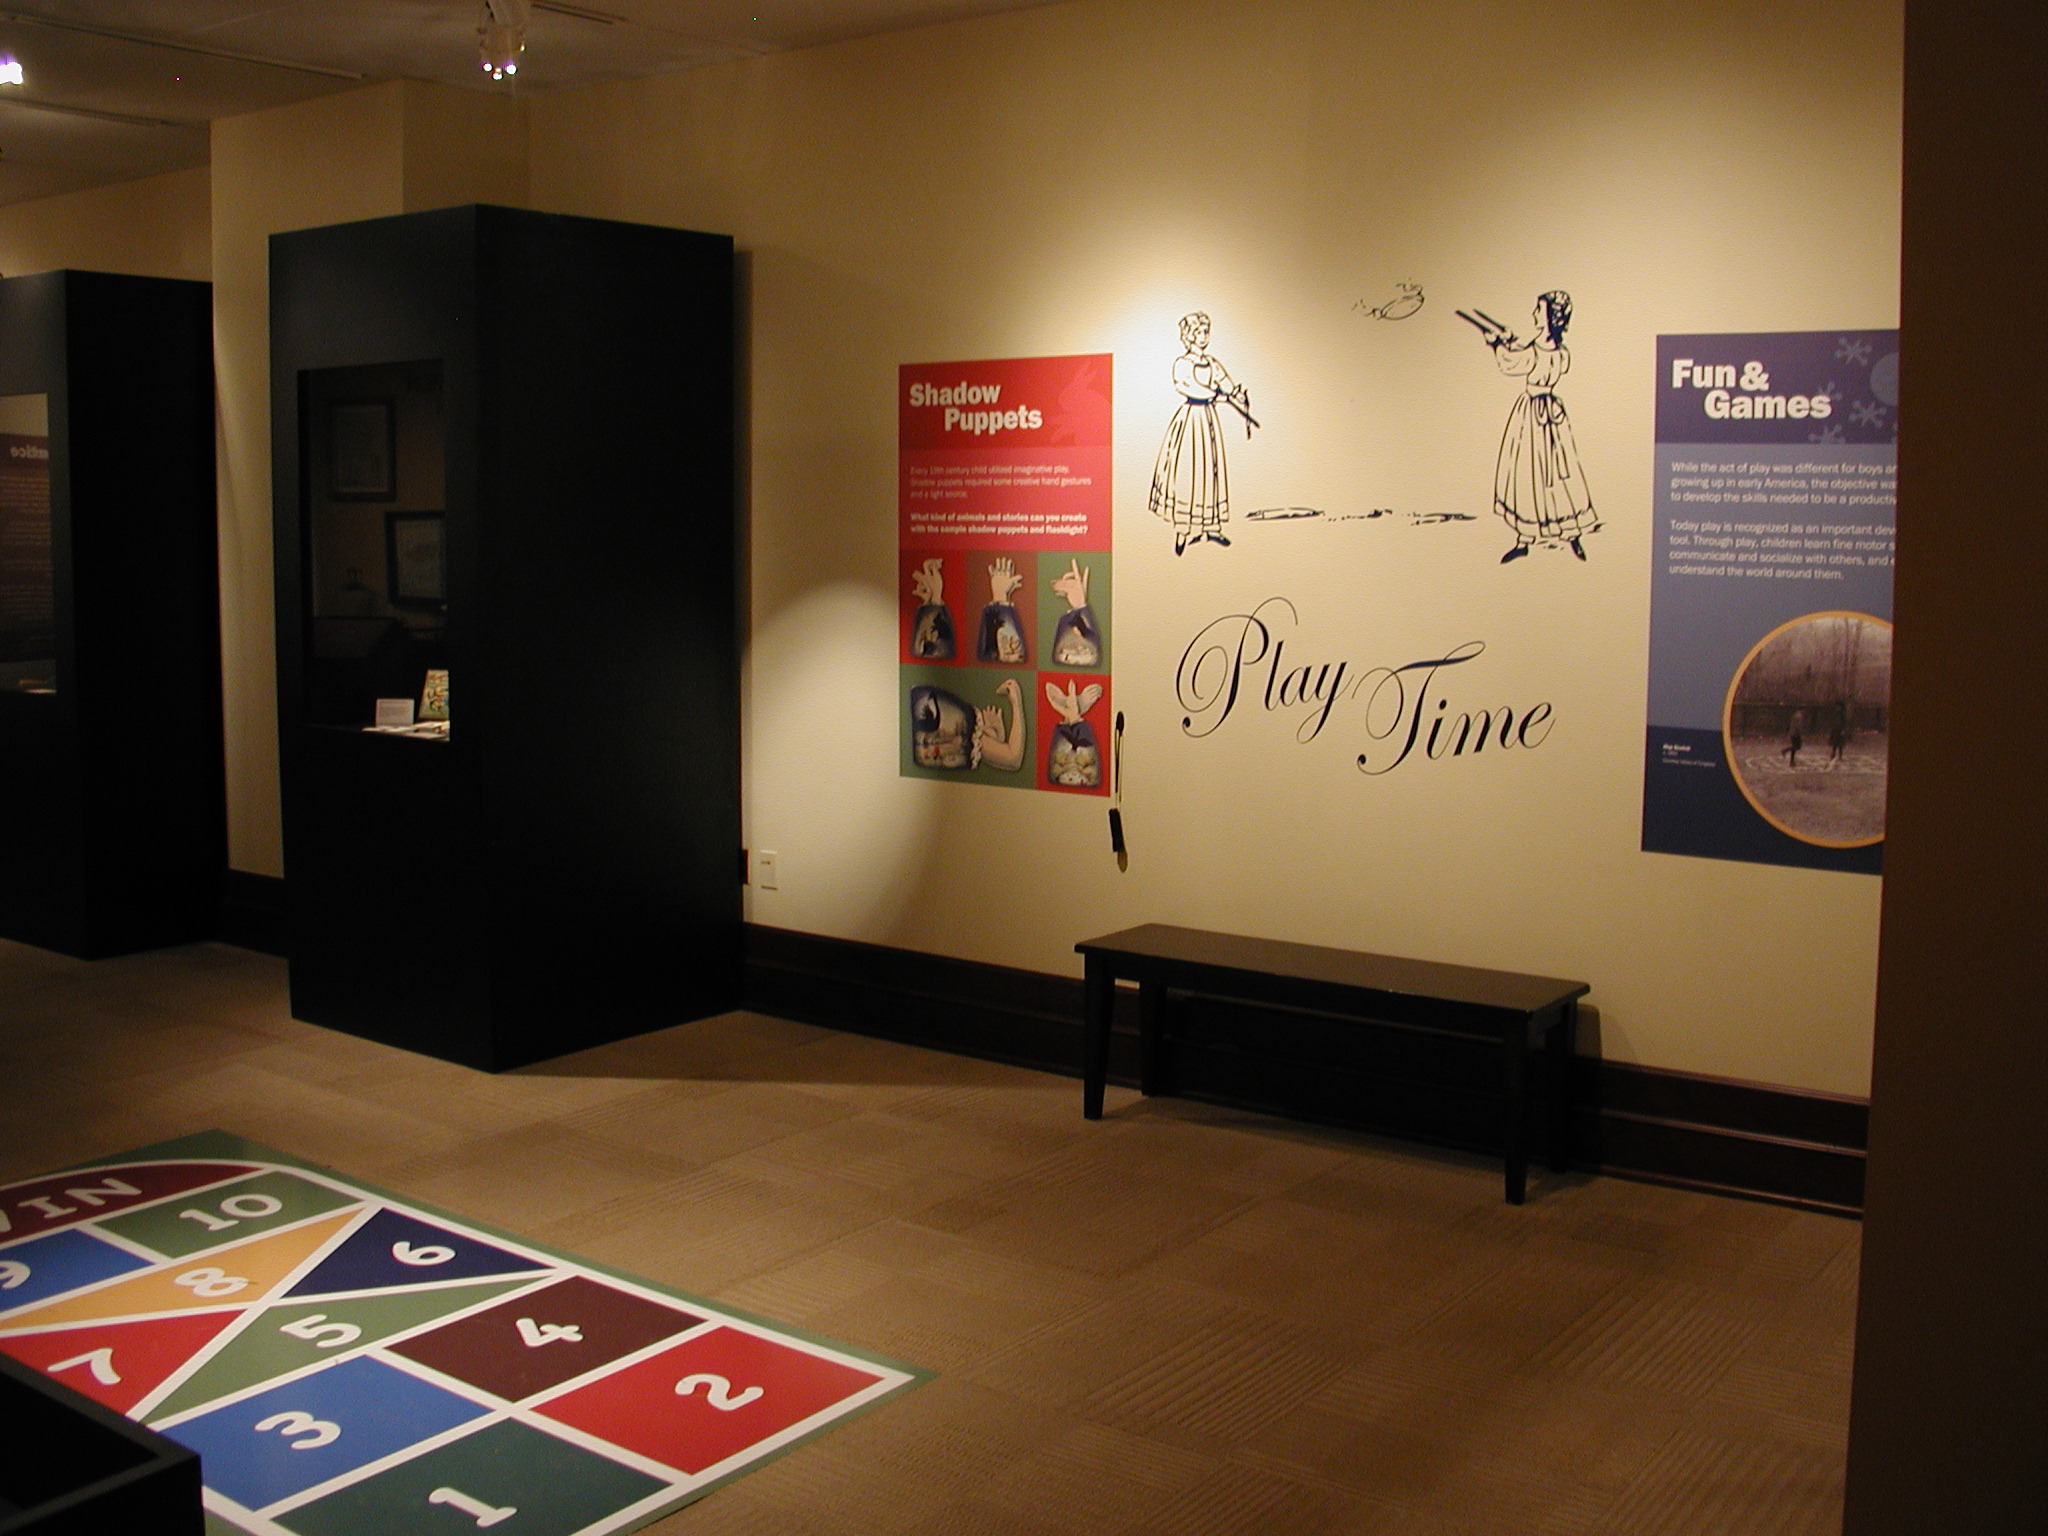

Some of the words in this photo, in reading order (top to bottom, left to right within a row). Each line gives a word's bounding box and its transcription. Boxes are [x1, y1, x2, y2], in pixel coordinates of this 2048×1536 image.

[1672, 359, 1736, 389] Fun
[1739, 361, 1769, 391] &
[909, 381, 1000, 407] Shadow
[1704, 390, 1832, 420] Games
[945, 405, 1043, 435] Puppets
[910, 466, 928, 476] Every
[946, 466, 969, 476] century
[971, 466, 987, 475] child
[1014, 466, 1052, 476] imaginative
[937, 478, 963, 487] puppets
[965, 477, 992, 487] required
[1013, 478, 1040, 486] creative
[1041, 477, 1060, 486] hand
[1061, 477, 1092, 487] gestures
[1671, 462, 1698, 473] While
[1700, 463, 1717, 473] the
[1719, 463, 1735, 473] act
[1737, 463, 1748, 473] of
[1749, 463, 1771, 475] play
[1772, 465, 1793, 474] was
[1795, 463, 1839, 474] different
[1841, 463, 1856, 474] for
[1858, 463, 1883, 476] boys
[1671, 477, 1709, 489] growing
[1711, 479, 1724, 489] up
[1726, 478, 1735, 488] in
[1738, 478, 1762, 490] early
[1764, 478, 1809, 489] America,
[1811, 478, 1828, 489] the
[1830, 478, 1878, 491] objective
[1671, 492, 1681, 501] to
[1683, 492, 1722, 503] develop
[1723, 492, 1740, 502] the
[1742, 493, 1767, 503] skills
[1770, 493, 1809, 504] needed
[1810, 494, 1821, 504] to
[1824, 494, 1837, 504] be
[1840, 496, 1846, 504] a
[910, 513, 929, 521] What
[930, 513, 946, 521] kind
[948, 513, 956, 521] of
[957, 513, 985, 521] animals
[987, 513, 1001, 521] and
[1002, 513, 1029, 522] stories
[1030, 514, 1044, 522] can
[1045, 514, 1060, 523] you
[1061, 513, 1087, 522] create
[910, 525, 925, 533] with
[927, 525, 939, 533] the
[940, 525, 967, 534] sample
[968, 525, 996, 533] shadow
[998, 525, 1028, 535] puppets
[1030, 525, 1044, 534] and
[1046, 525, 1089, 536] flashlight?
[1670, 519, 1699, 533] Today
[1701, 521, 1722, 534] play
[1723, 522, 1732, 532] is
[1734, 522, 1789, 534] recognized
[1791, 525, 1803, 534] as
[1806, 525, 1819, 534] an
[1822, 524, 1872, 536] important
[1670, 535, 1690, 545] tool.
[1693, 535, 1733, 549] Through
[1735, 536, 1759, 550] play,
[1761, 538, 1802, 549] children
[1804, 538, 1831, 549] learn
[1833, 539, 1853, 550] fine
[1855, 541, 1887, 551] motor
[1669, 550, 1736, 562] communicate
[1738, 552, 1757, 562] and
[1759, 552, 1803, 563] socialize
[1805, 553, 1827, 564] with
[1829, 555, 1865, 566] others,
[1868, 555, 1889, 566] and
[1669, 564, 1725, 576] understand
[1727, 566, 1744, 576] the
[1746, 567, 1773, 578] world
[1775, 568, 1812, 579] around
[1814, 568, 1844, 580] them.
[1176, 597, 1354, 744] Play
[1351, 641, 1556, 775] Time
[0, 1178, 142, 1232] IN
[179, 1194, 282, 1231] 10
[392, 1239, 456, 1266] 6
[174, 1267, 248, 1297] 8
[280, 1313, 362, 1349] 5
[516, 1317, 584, 1349] 4
[47, 1347, 122, 1387] 7
[674, 1373, 764, 1412] 2
[255, 1410, 342, 1451] 3
[428, 1486, 518, 1529] 1
